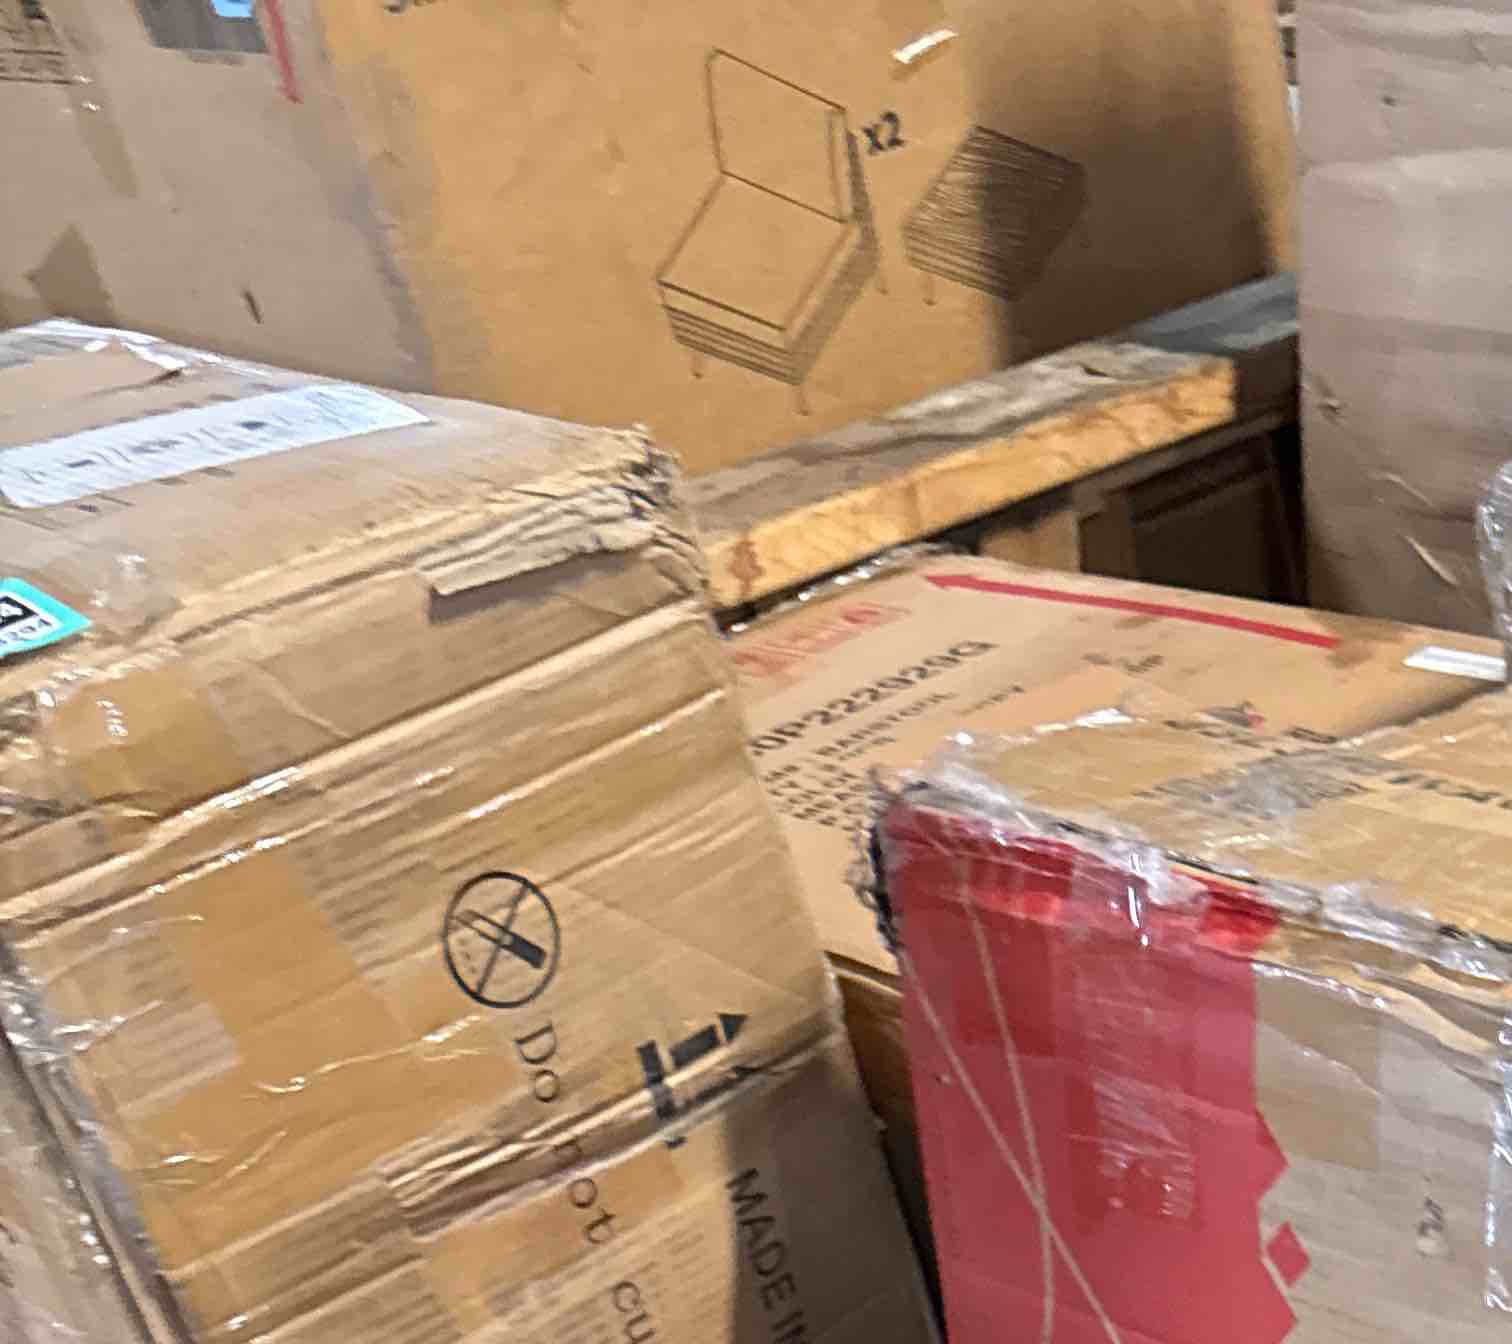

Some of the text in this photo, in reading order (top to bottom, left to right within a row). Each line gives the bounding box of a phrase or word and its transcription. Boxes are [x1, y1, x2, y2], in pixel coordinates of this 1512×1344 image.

[860, 111, 907, 157] x2
[514, 1020, 562, 1104] Do
[727, 1168, 799, 1308] MADE
